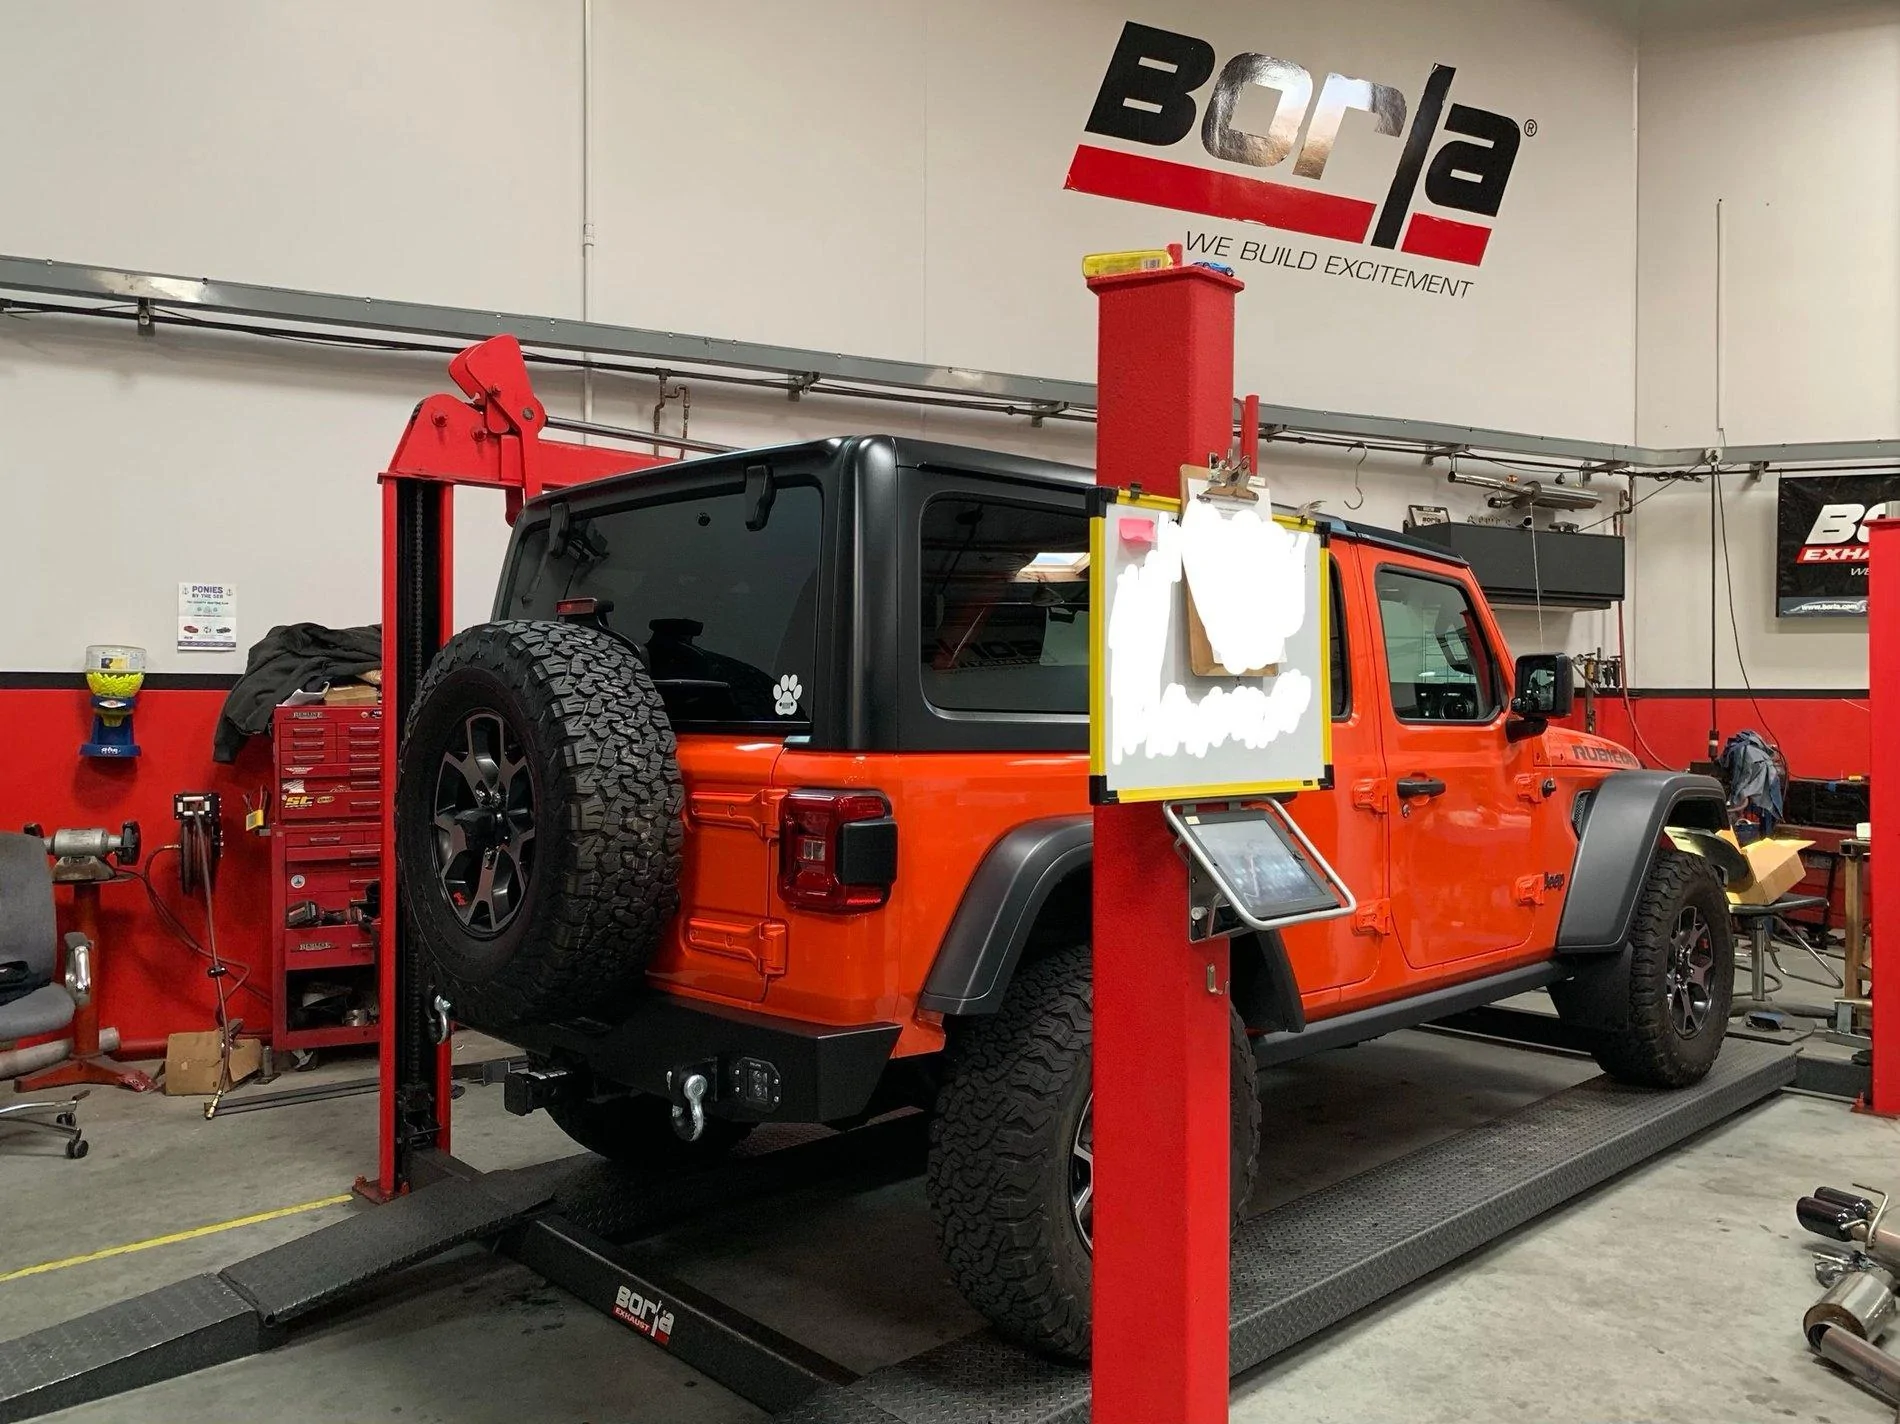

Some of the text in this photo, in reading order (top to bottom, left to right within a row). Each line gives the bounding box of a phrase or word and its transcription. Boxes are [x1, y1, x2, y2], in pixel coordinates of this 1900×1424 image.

[1184, 230, 1474, 299] WE BUILD EXCITEMENT
[192, 585, 224, 594] PONIES
[1572, 745, 1638, 766] RUBICON
[615, 1307, 651, 1331] EXHAUST
